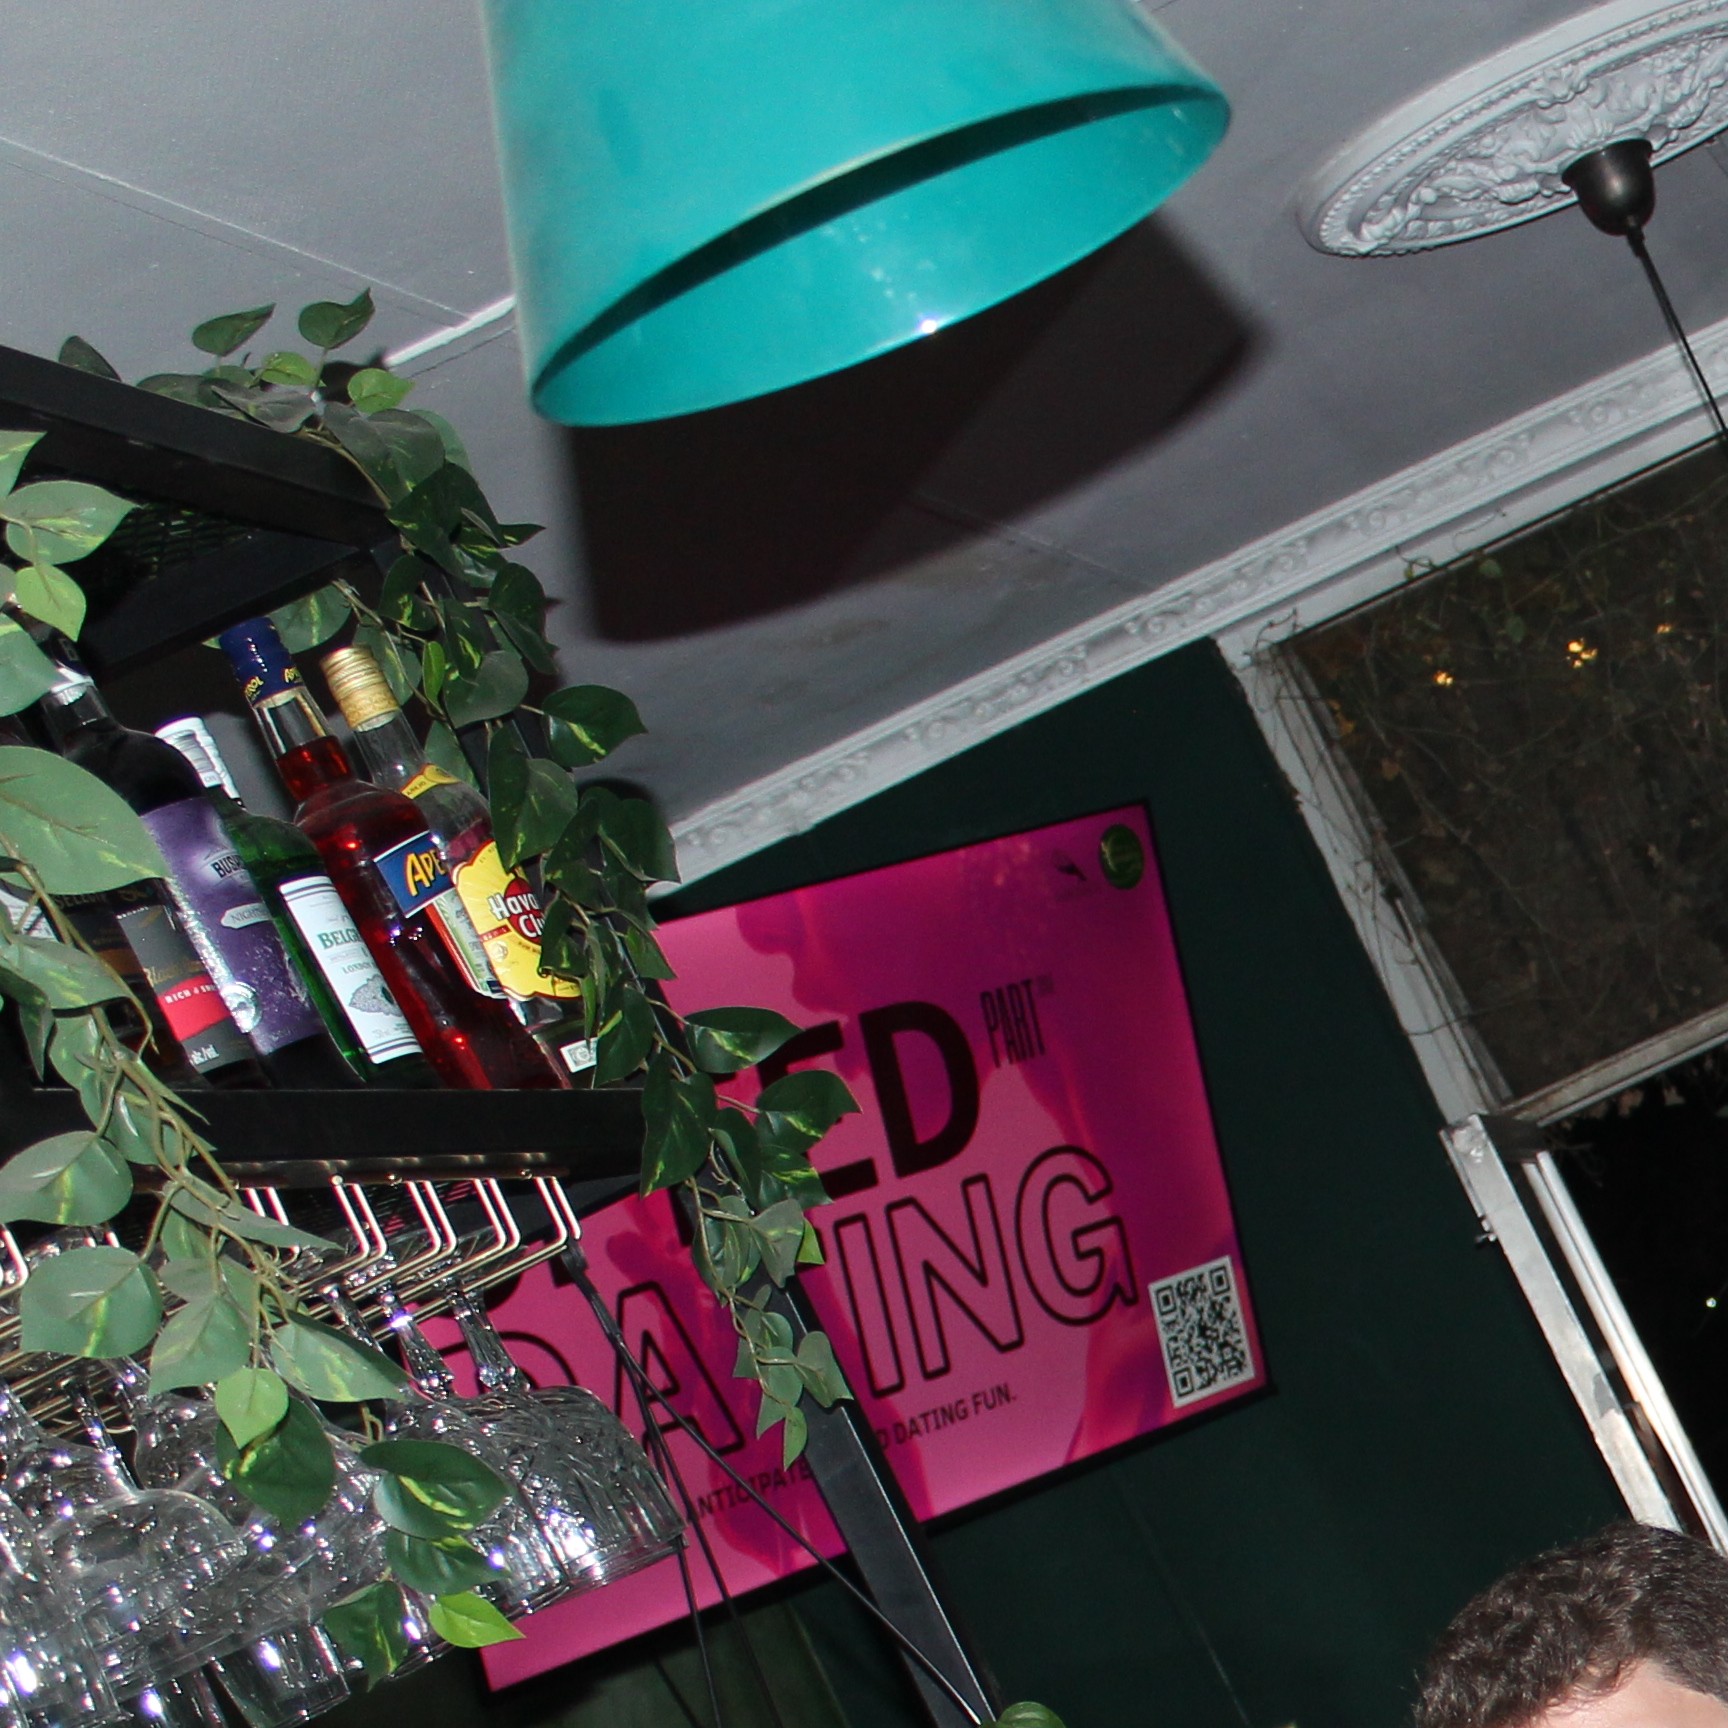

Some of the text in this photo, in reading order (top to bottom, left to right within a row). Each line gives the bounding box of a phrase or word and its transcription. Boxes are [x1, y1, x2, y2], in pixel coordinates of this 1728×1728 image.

[165, 989, 192, 1004] RICH
[895, 1399, 970, 1446] DATING
[972, 1384, 1017, 1414] FUN.
